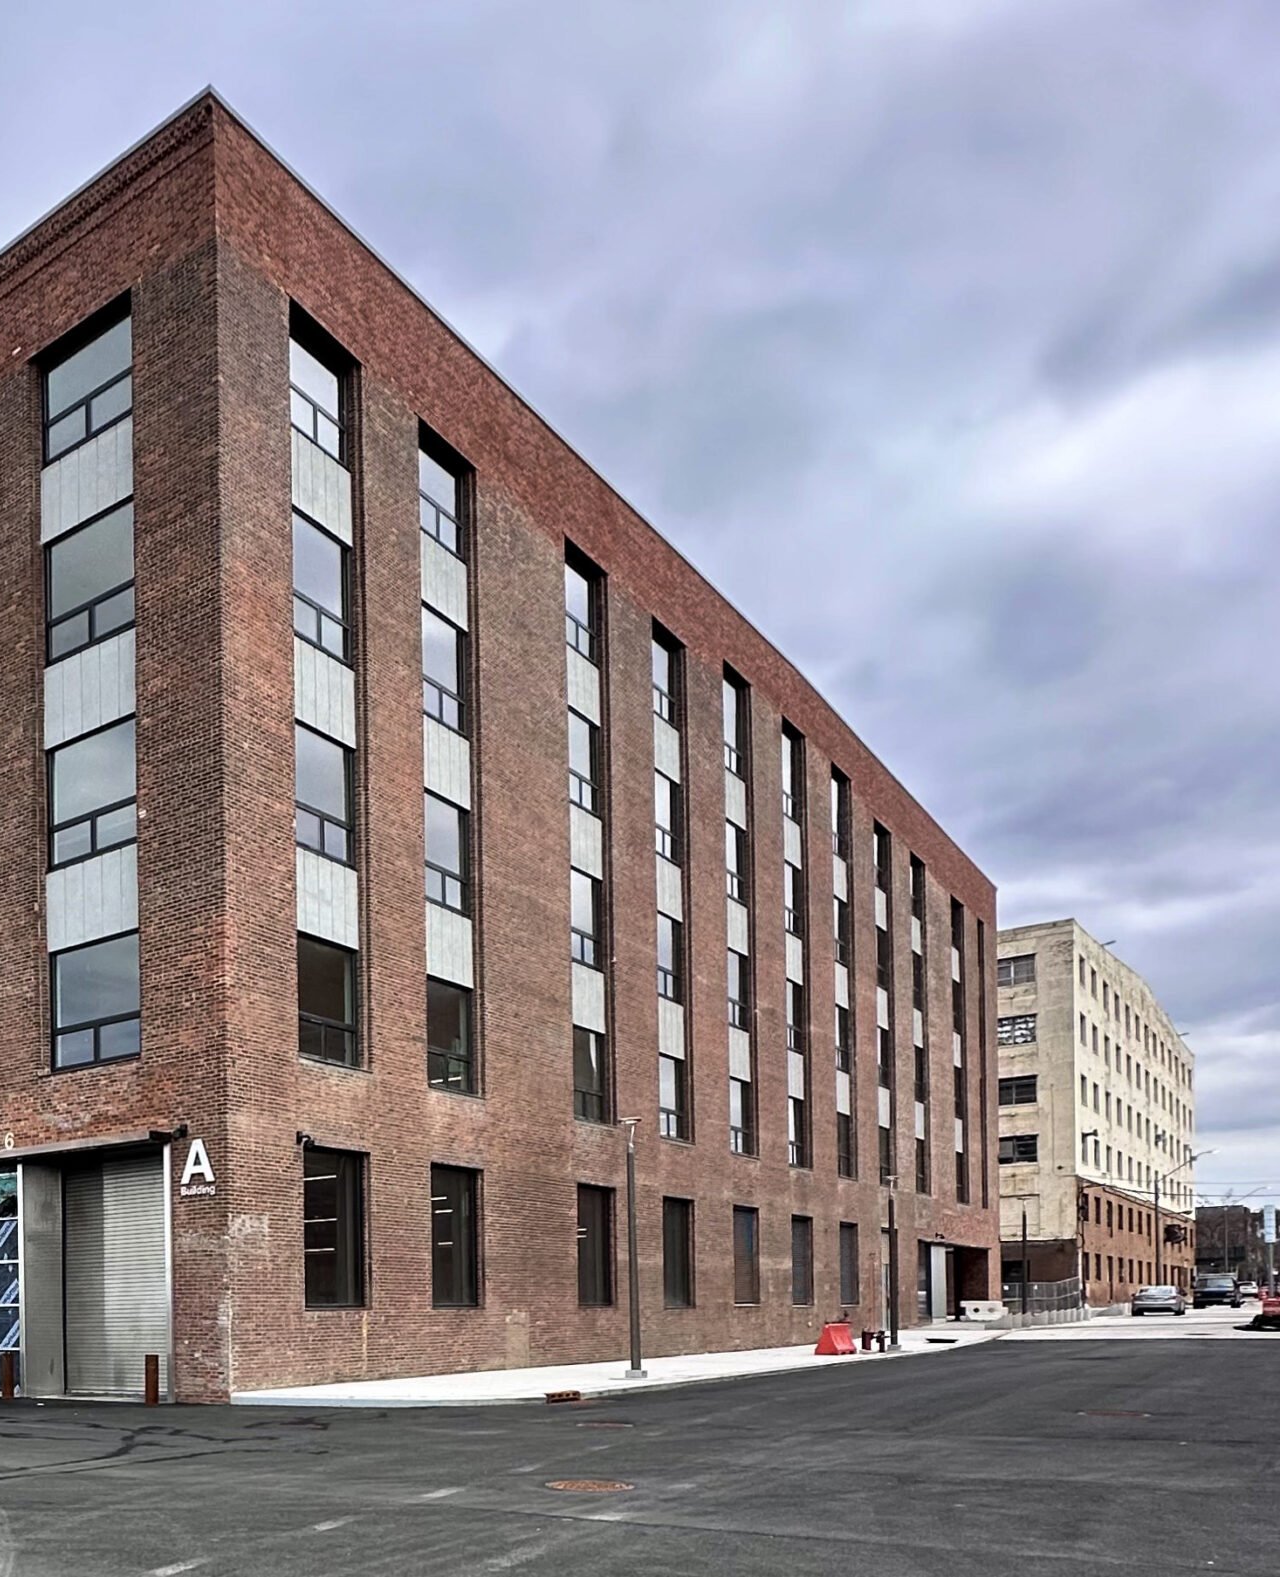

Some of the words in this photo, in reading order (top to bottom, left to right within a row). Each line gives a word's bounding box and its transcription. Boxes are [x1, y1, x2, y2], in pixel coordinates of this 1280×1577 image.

[5, 1132, 14, 1150] 6
[180, 1138, 215, 1184] A
[180, 1185, 215, 1196] Building
